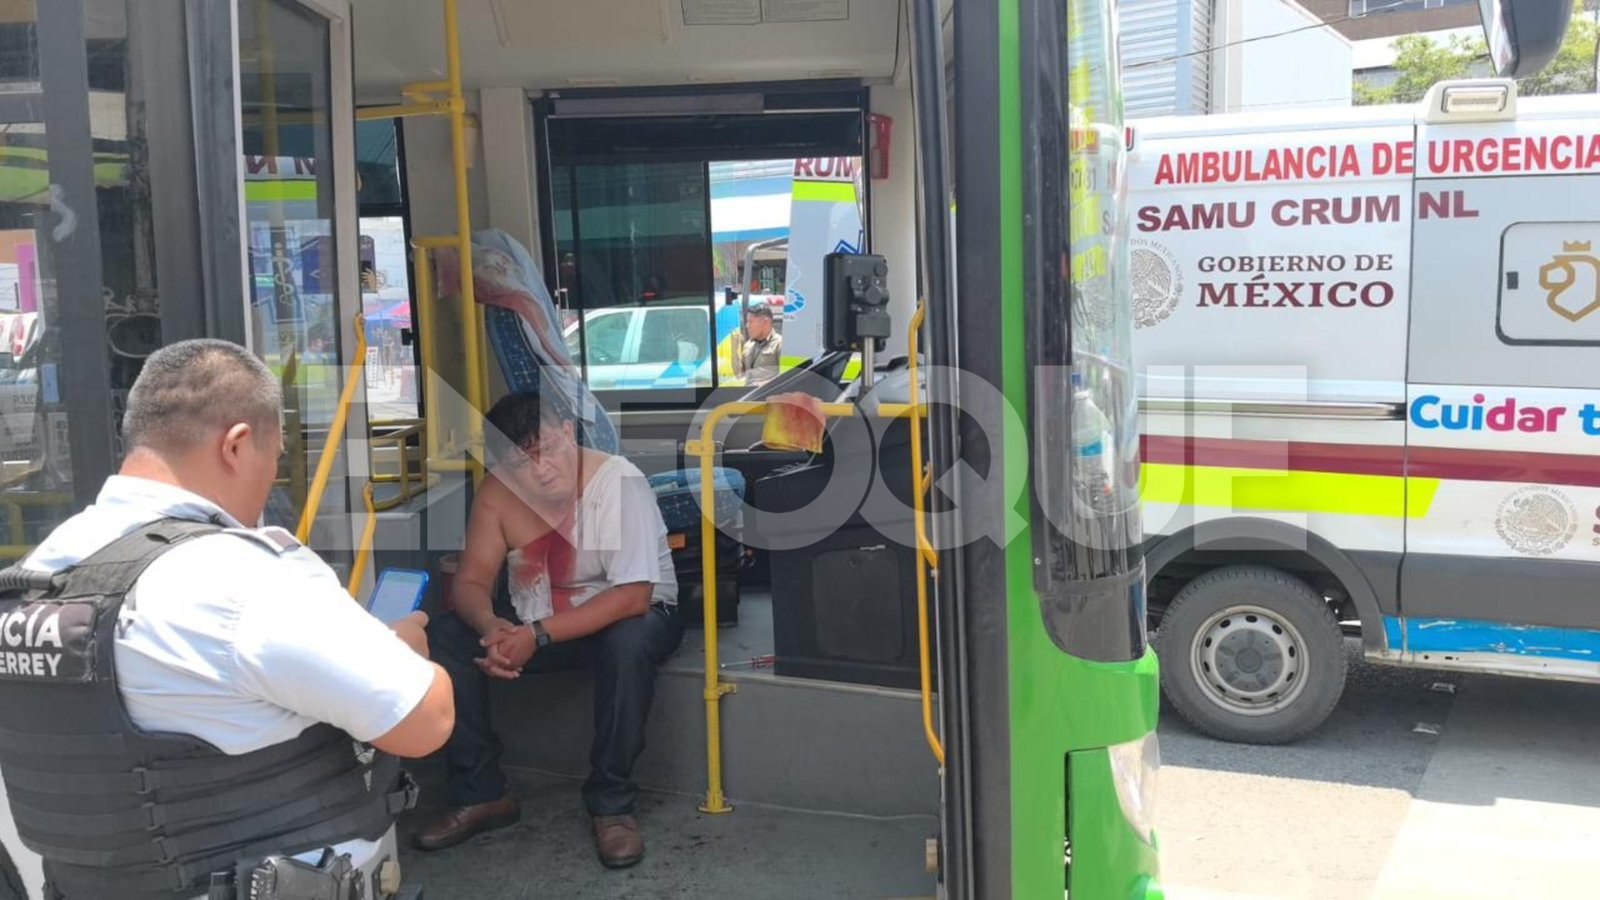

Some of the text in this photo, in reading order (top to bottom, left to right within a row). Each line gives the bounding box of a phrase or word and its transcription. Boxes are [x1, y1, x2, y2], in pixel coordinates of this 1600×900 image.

[1154, 144, 1360, 185] AMBULANCIA
[1372, 141, 1414, 175] DE
[1136, 201, 1256, 232] SAMU
[1271, 194, 1400, 226] CRUM
[1418, 190, 1479, 219] NL
[1197, 253, 1394, 273] GOBIERNO DE
[1196, 273, 1394, 308] MÉXICO
[1410, 393, 1567, 433] Cuidar
